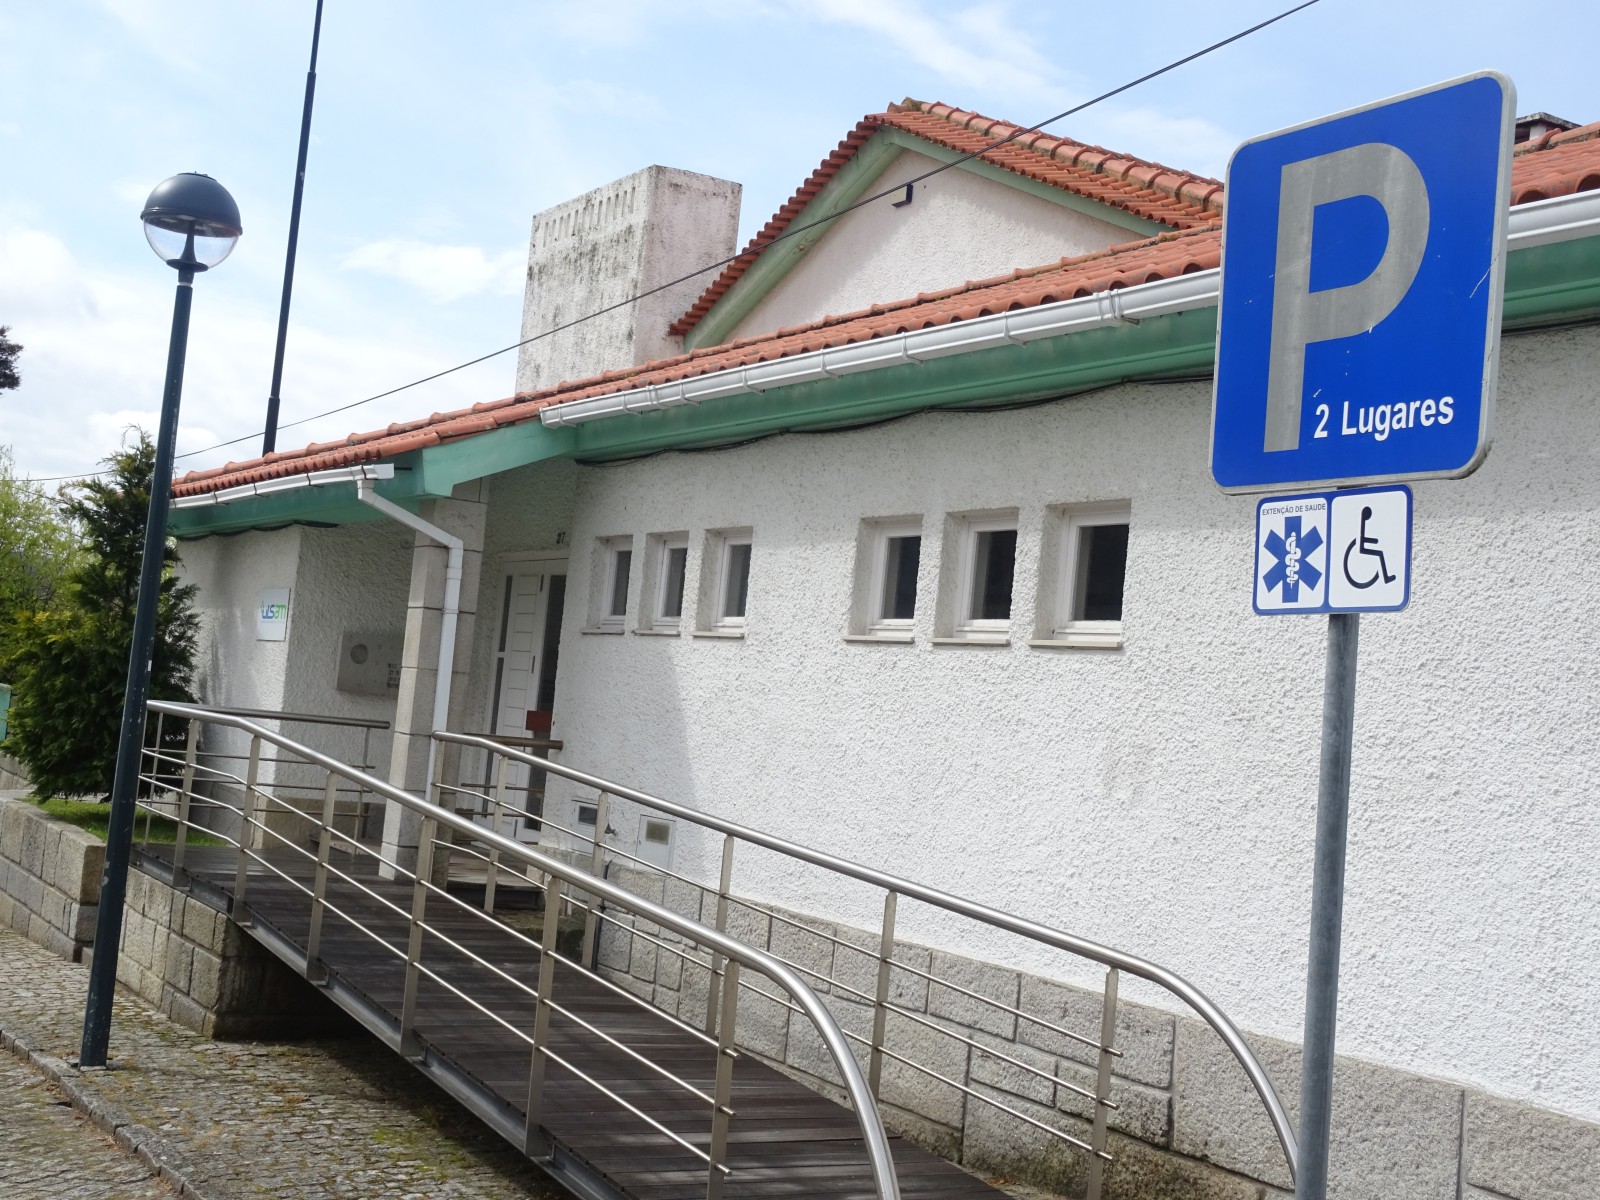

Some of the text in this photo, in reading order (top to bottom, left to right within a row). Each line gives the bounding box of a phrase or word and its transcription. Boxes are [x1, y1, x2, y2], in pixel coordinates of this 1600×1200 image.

[1264, 142, 1430, 453] P
[1313, 396, 1454, 442] 2 Lugares
[1262, 505, 1294, 516] EXTENÇÃO
[1295, 505, 1304, 513] DE
